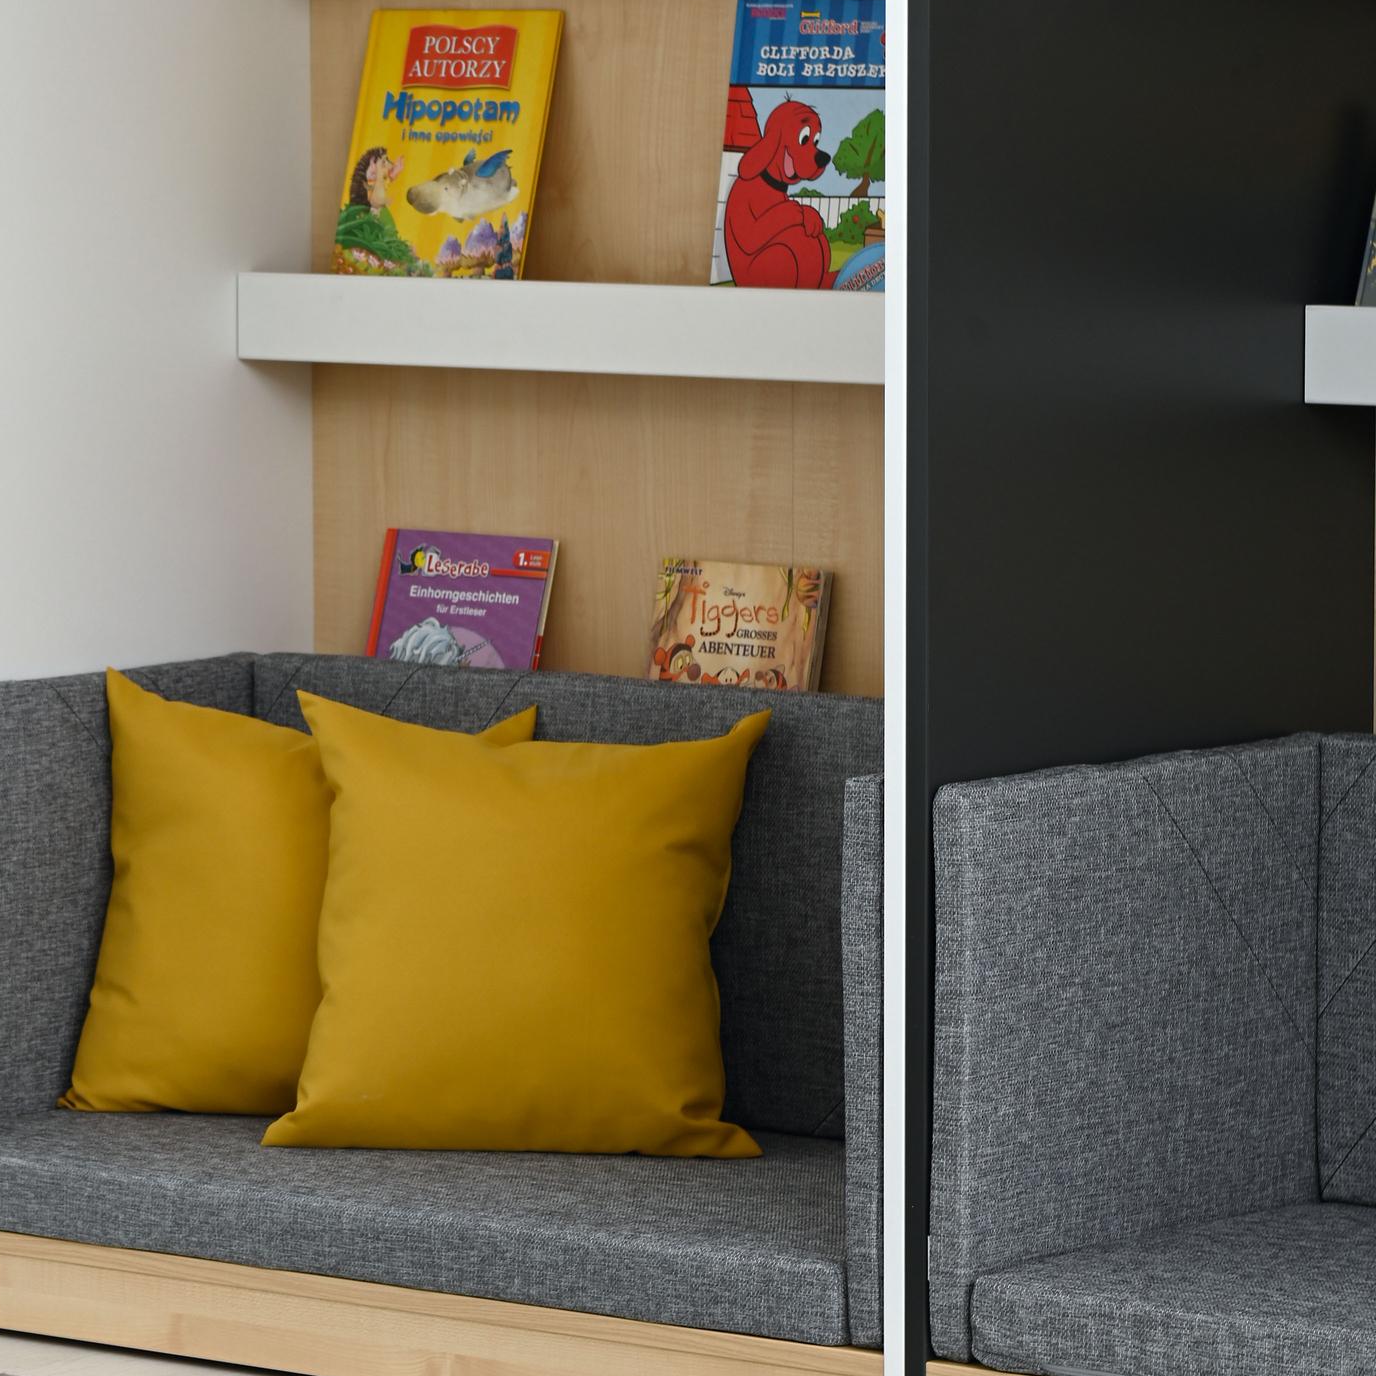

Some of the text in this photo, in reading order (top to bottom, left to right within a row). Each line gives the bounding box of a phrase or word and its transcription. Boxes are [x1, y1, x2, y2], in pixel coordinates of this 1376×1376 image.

[799, 19, 859, 35] Clifford
[422, 35, 500, 55] POLSCY
[760, 46, 855, 61] CLIFFORDA
[408, 59, 507, 78] AUTORZY
[756, 62, 795, 77] BOLI
[382, 90, 521, 127] Hipopotam
[408, 128, 432, 142] inne
[425, 553, 489, 579] Leserabe
[409, 585, 520, 605] Einhorngeschichten
[436, 604, 487, 617] für Erstleser
[681, 581, 779, 638] Tiggers
[736, 628, 778, 642] GROSSES
[698, 641, 776, 660] ABENTEUER
